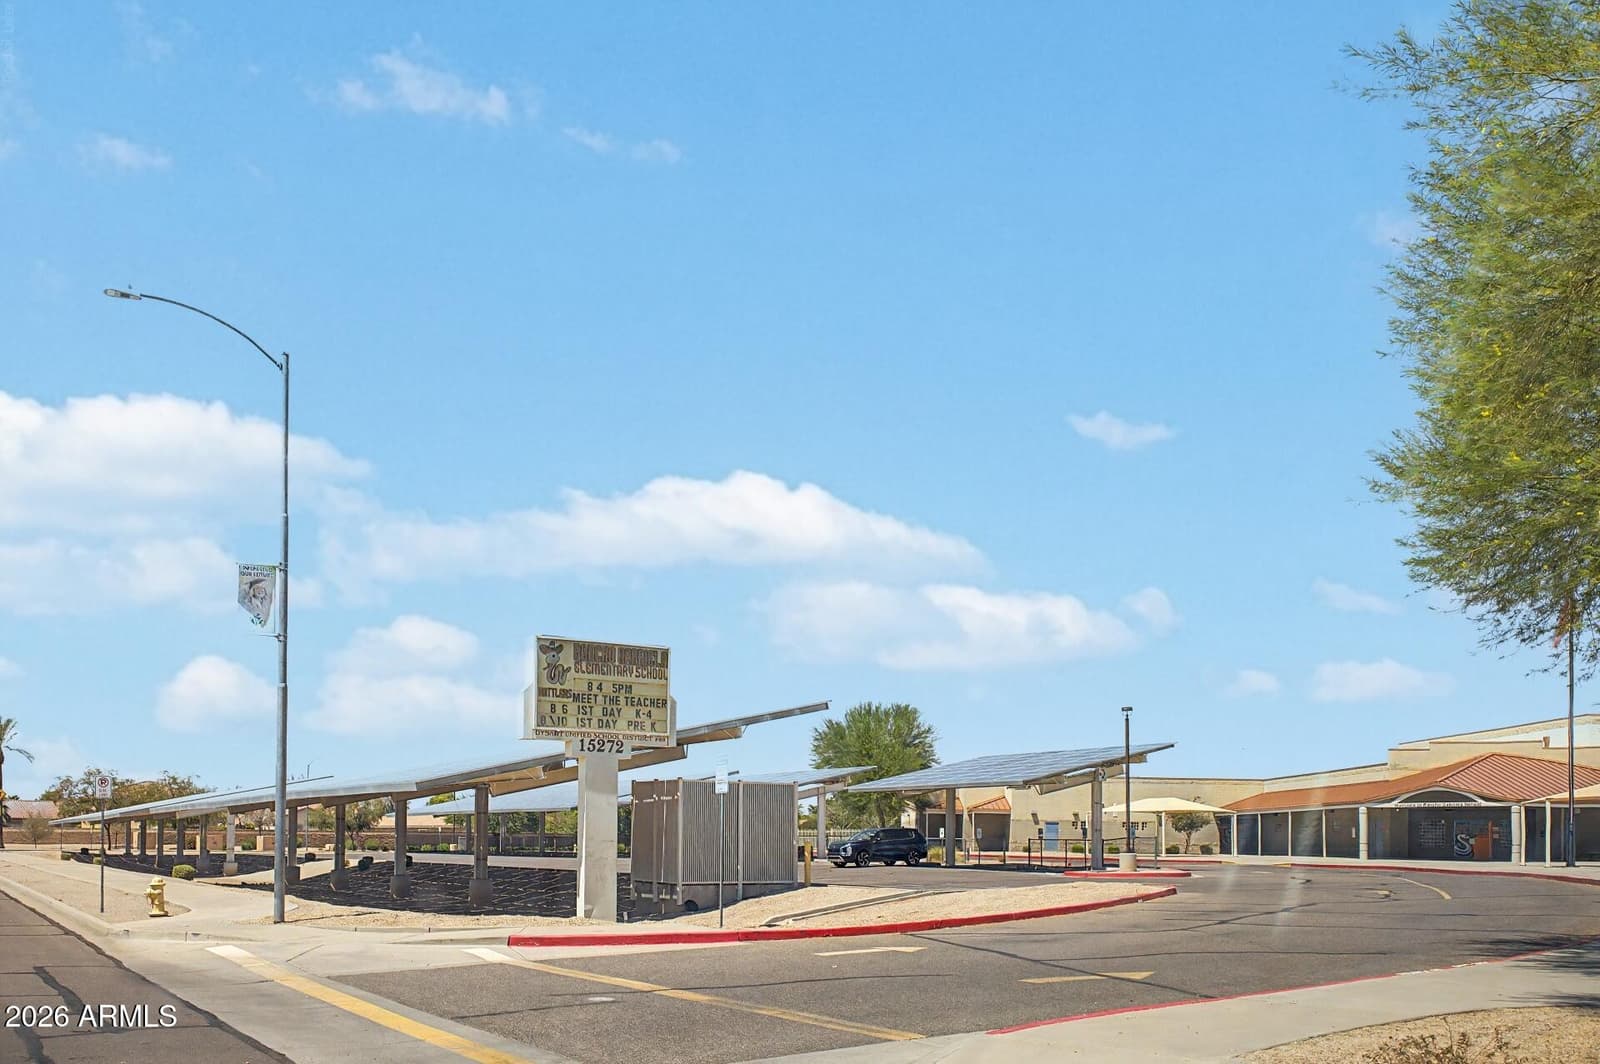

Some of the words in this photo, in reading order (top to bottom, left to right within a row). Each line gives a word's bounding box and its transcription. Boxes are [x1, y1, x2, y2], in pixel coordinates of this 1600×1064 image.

[635, 666, 668, 680] SCHOOL
[587, 682, 593, 692] 8
[596, 682, 603, 692] 4
[612, 684, 632, 694] 5PM
[572, 692, 599, 704] MEET
[602, 695, 621, 706] THE
[624, 697, 667, 709] TEACHER
[562, 704, 568, 714] 6
[602, 706, 622, 718] DAY
[635, 709, 652, 719] K-4
[598, 718, 618, 729] DAY
[627, 720, 645, 731] PRE
[650, 721, 657, 732] K
[579, 738, 624, 753] 15272
